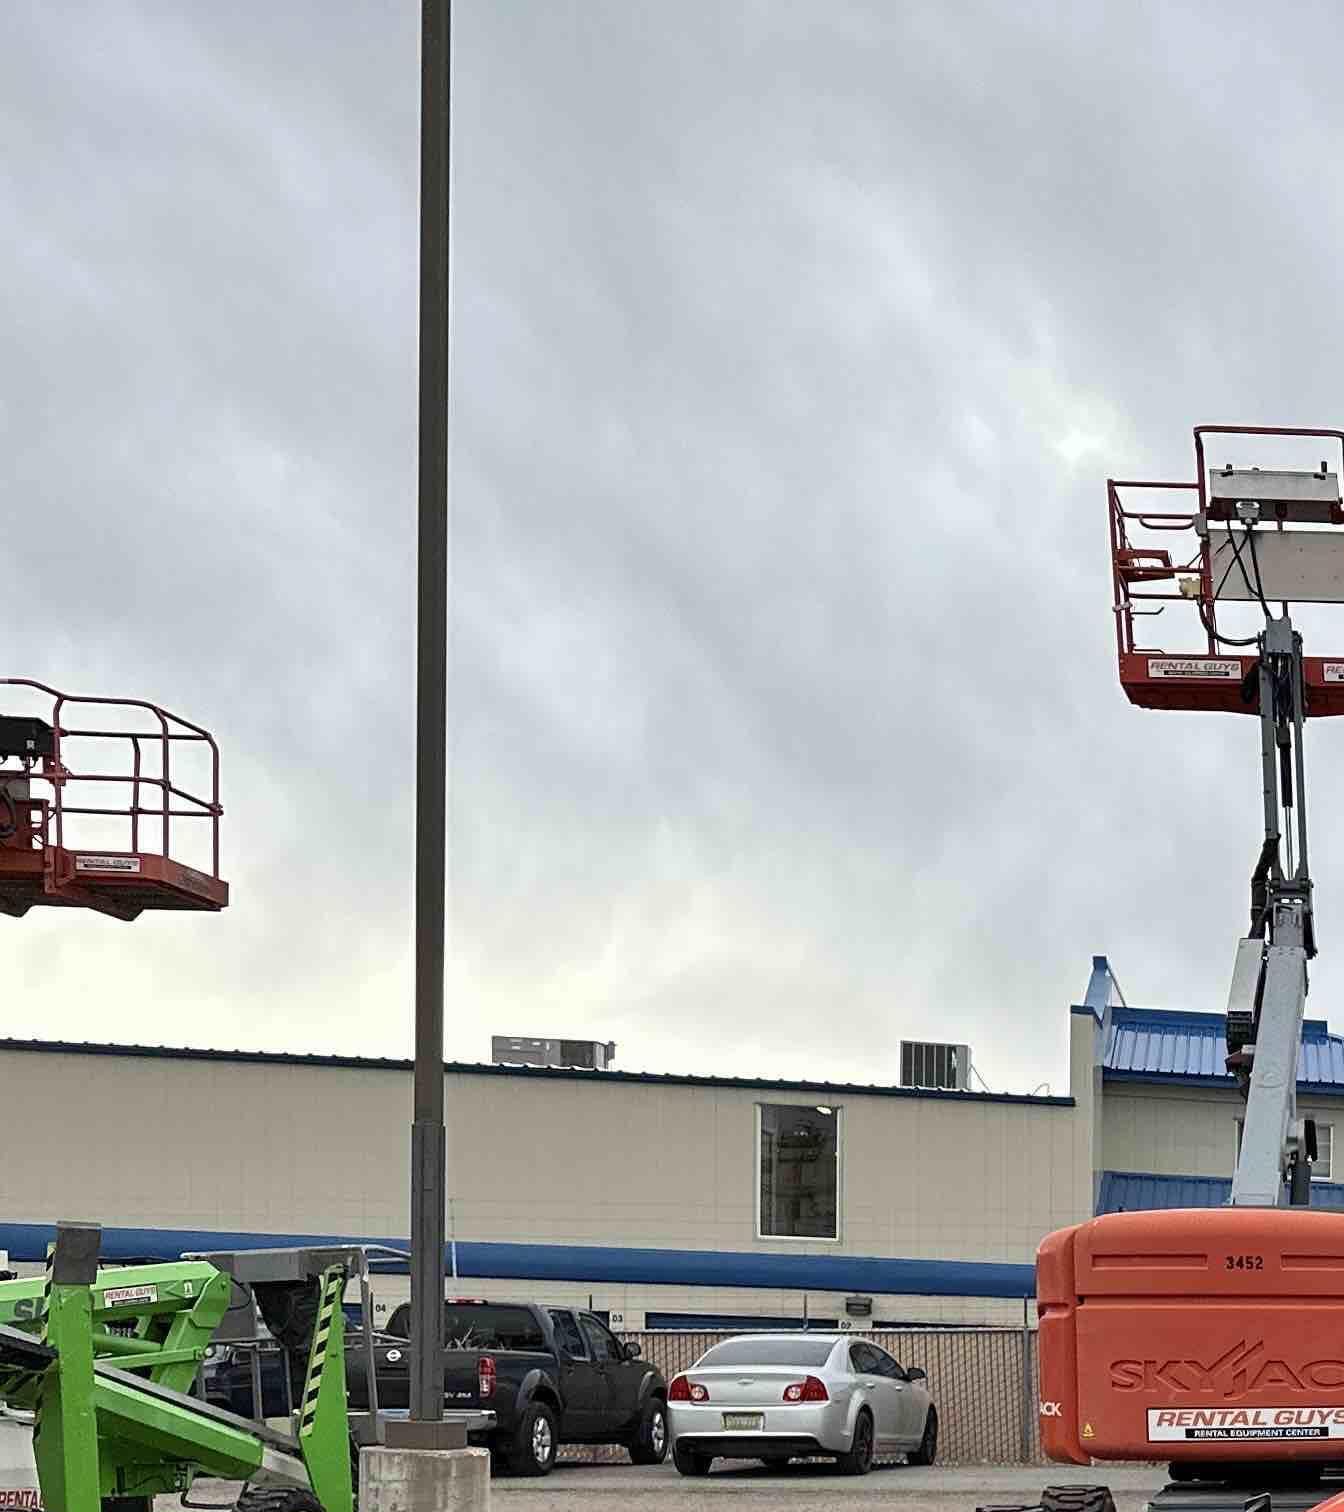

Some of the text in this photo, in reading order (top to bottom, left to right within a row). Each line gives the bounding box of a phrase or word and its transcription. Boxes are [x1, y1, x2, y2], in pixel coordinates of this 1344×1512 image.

[1149, 661, 1240, 671] RENTAL GUYS
[1225, 1255, 1264, 1270] 3452
[375, 1304, 386, 1313] 04
[1156, 1410, 1268, 1427] RENTAL
[1193, 1428, 1321, 1438] RENTAL EQUIPMENT CENTER
